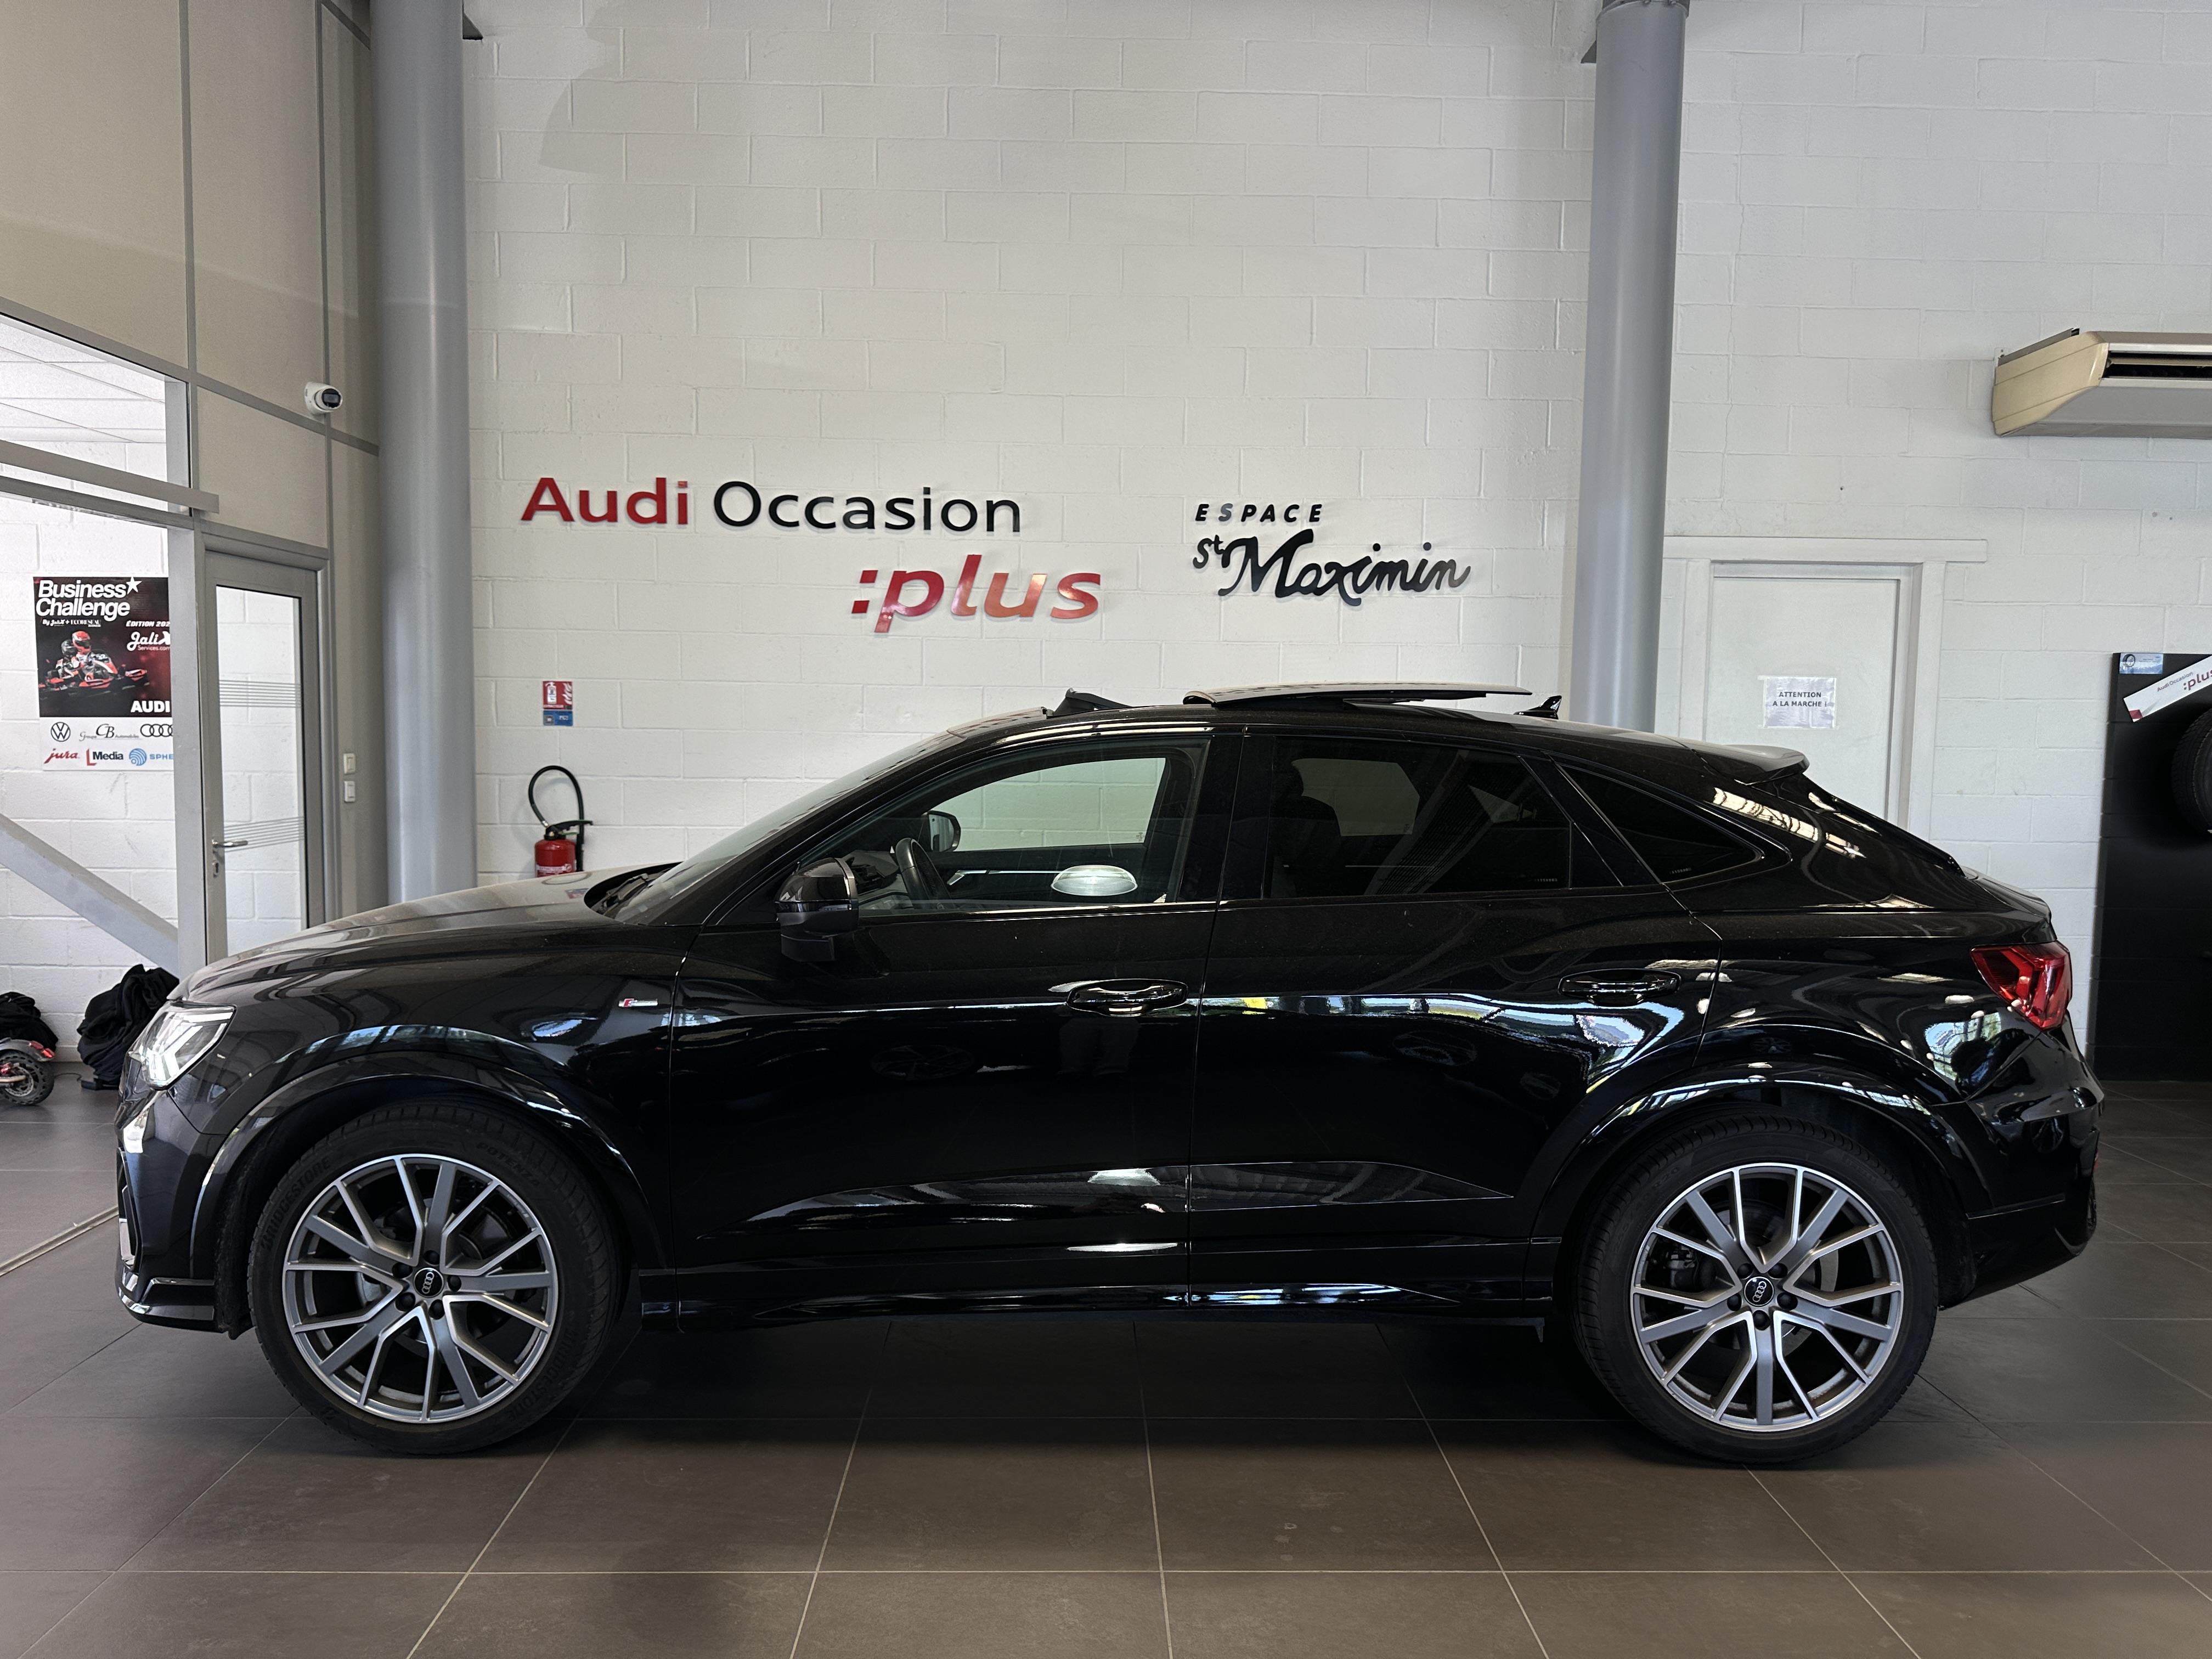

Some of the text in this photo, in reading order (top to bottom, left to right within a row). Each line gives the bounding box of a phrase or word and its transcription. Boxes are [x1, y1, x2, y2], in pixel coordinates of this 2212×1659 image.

[521, 477, 1021, 532] Audi Occasion
[1195, 504, 1322, 522] ESPACE
[1217, 528, 1471, 606] Maximin
[38, 579, 127, 598] Business
[850, 554, 1101, 634] :plus
[36, 597, 131, 622] Challenge
[2157, 671, 2193, 692] Audi Occasion
[131, 700, 171, 713] AUDI
[44, 748, 79, 764] jura
